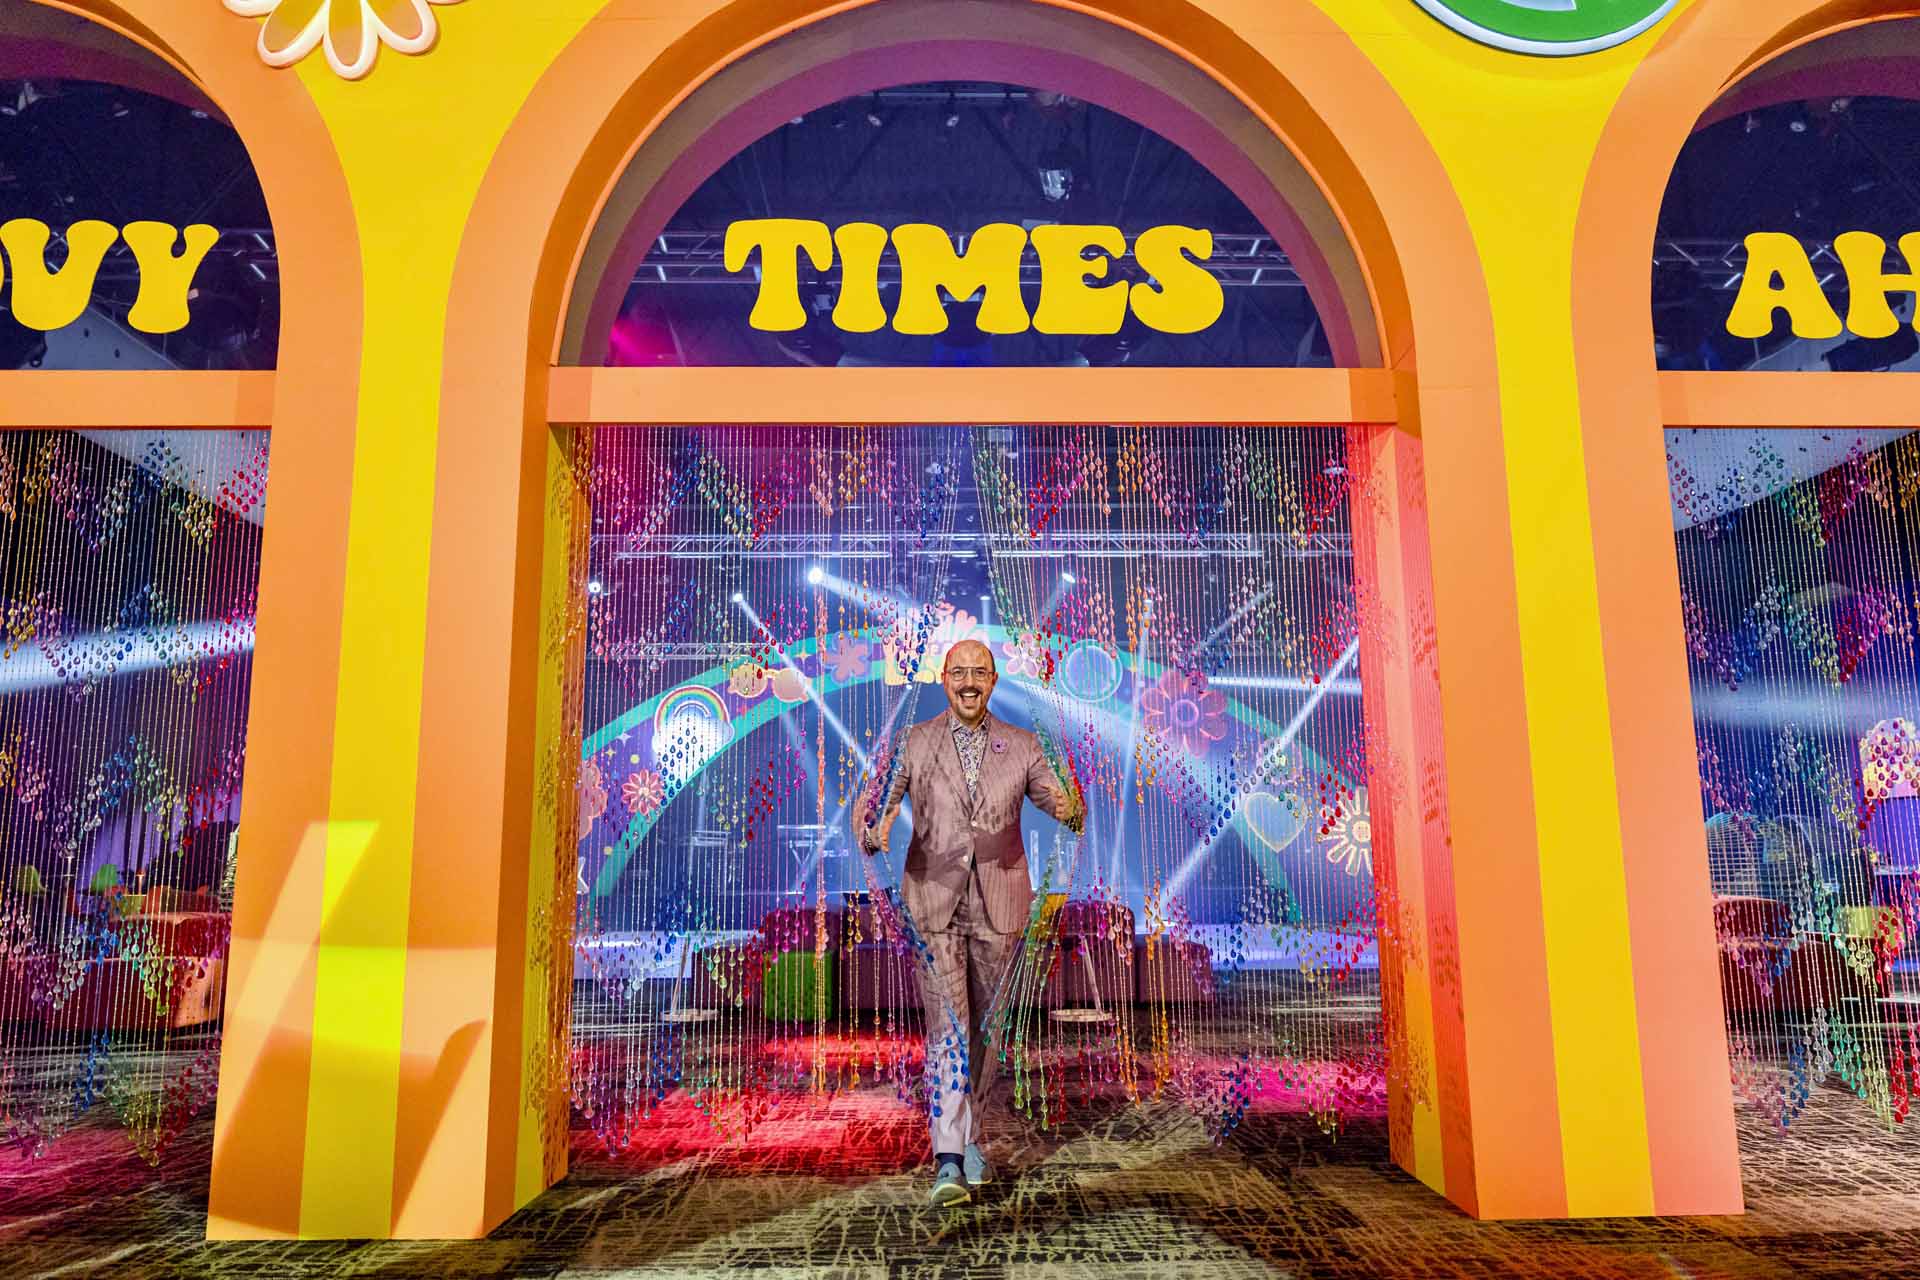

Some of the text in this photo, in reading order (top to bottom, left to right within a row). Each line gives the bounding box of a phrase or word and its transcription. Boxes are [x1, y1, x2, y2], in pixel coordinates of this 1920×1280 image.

[0, 218, 220, 334] VY
[724, 219, 1224, 335] TIMES
[1725, 231, 1920, 339] AH
